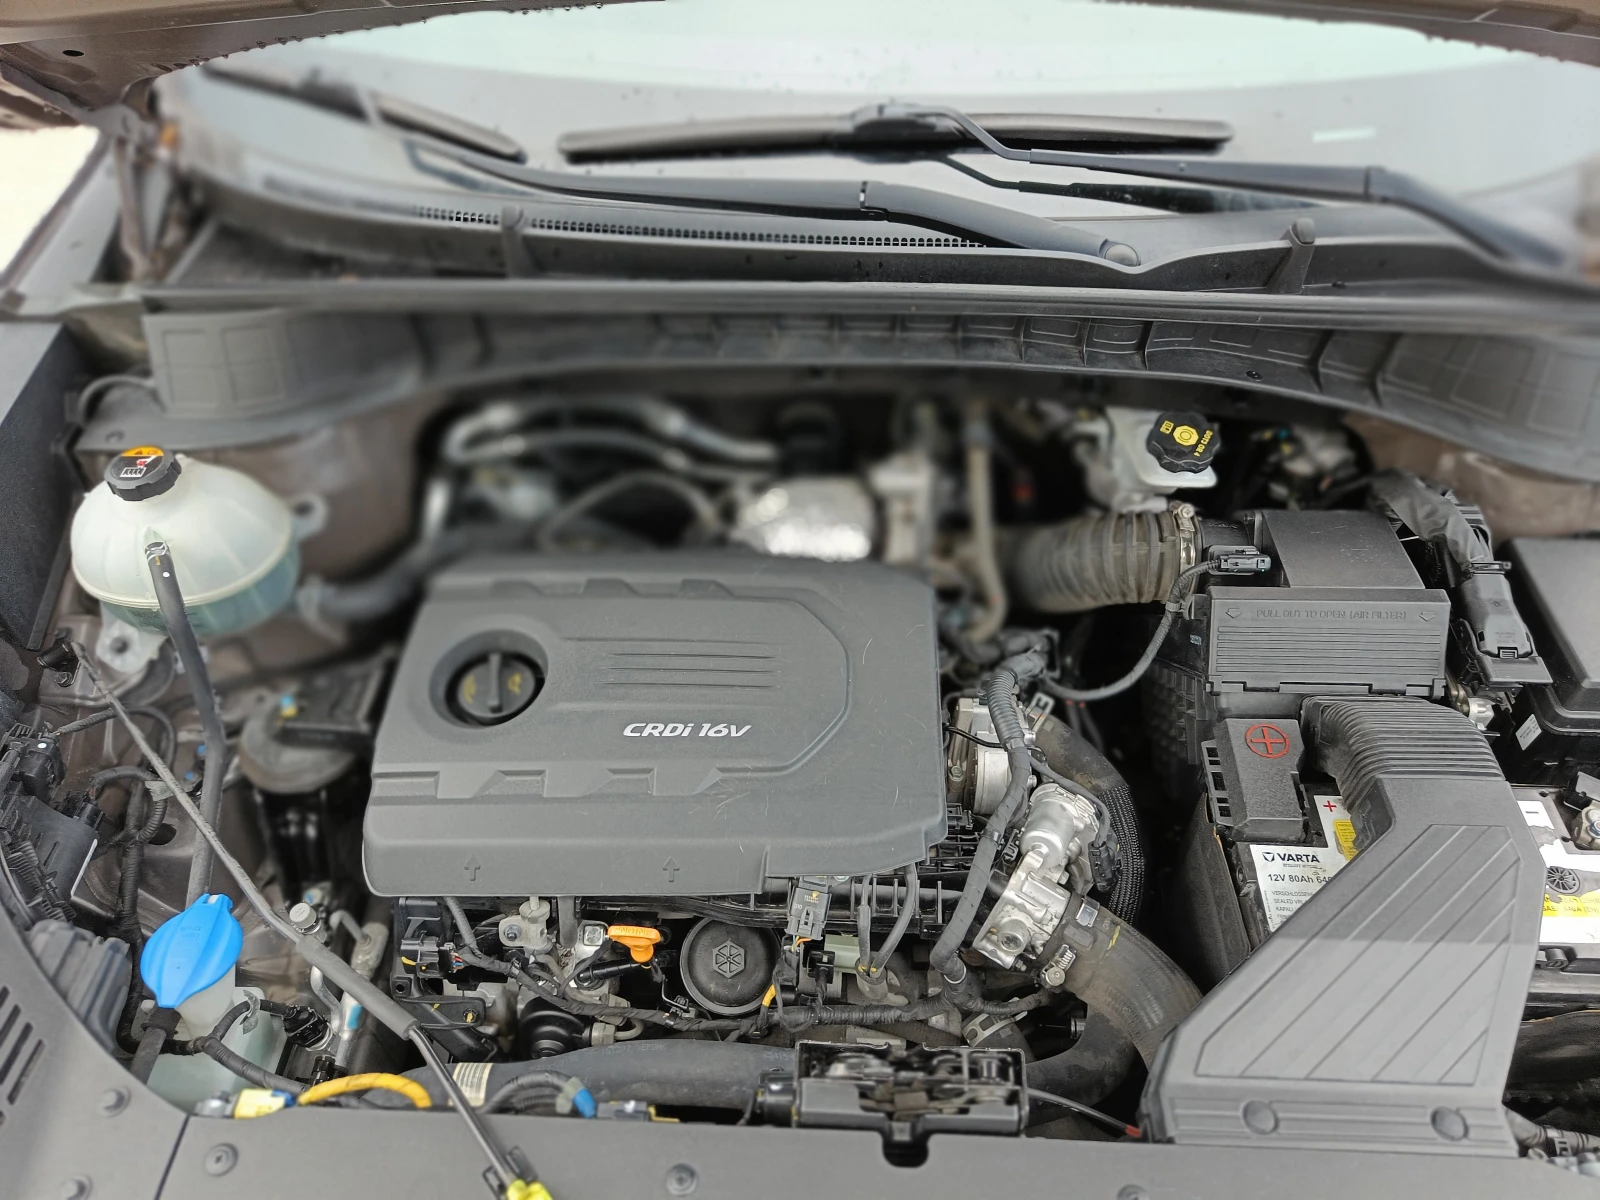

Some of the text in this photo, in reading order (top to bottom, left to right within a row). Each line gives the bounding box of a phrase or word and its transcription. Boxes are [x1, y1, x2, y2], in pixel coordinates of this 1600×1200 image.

[1256, 609, 1282, 618] PULL
[1282, 610, 1301, 618] OUT
[1305, 610, 1318, 618] TO
[1319, 610, 1346, 619] OPEN
[622, 722, 752, 737] CRDi 16V
[1276, 853, 1321, 863] VARTA
[1268, 874, 1286, 882] 12V
[1288, 874, 1314, 884] 80Ah
